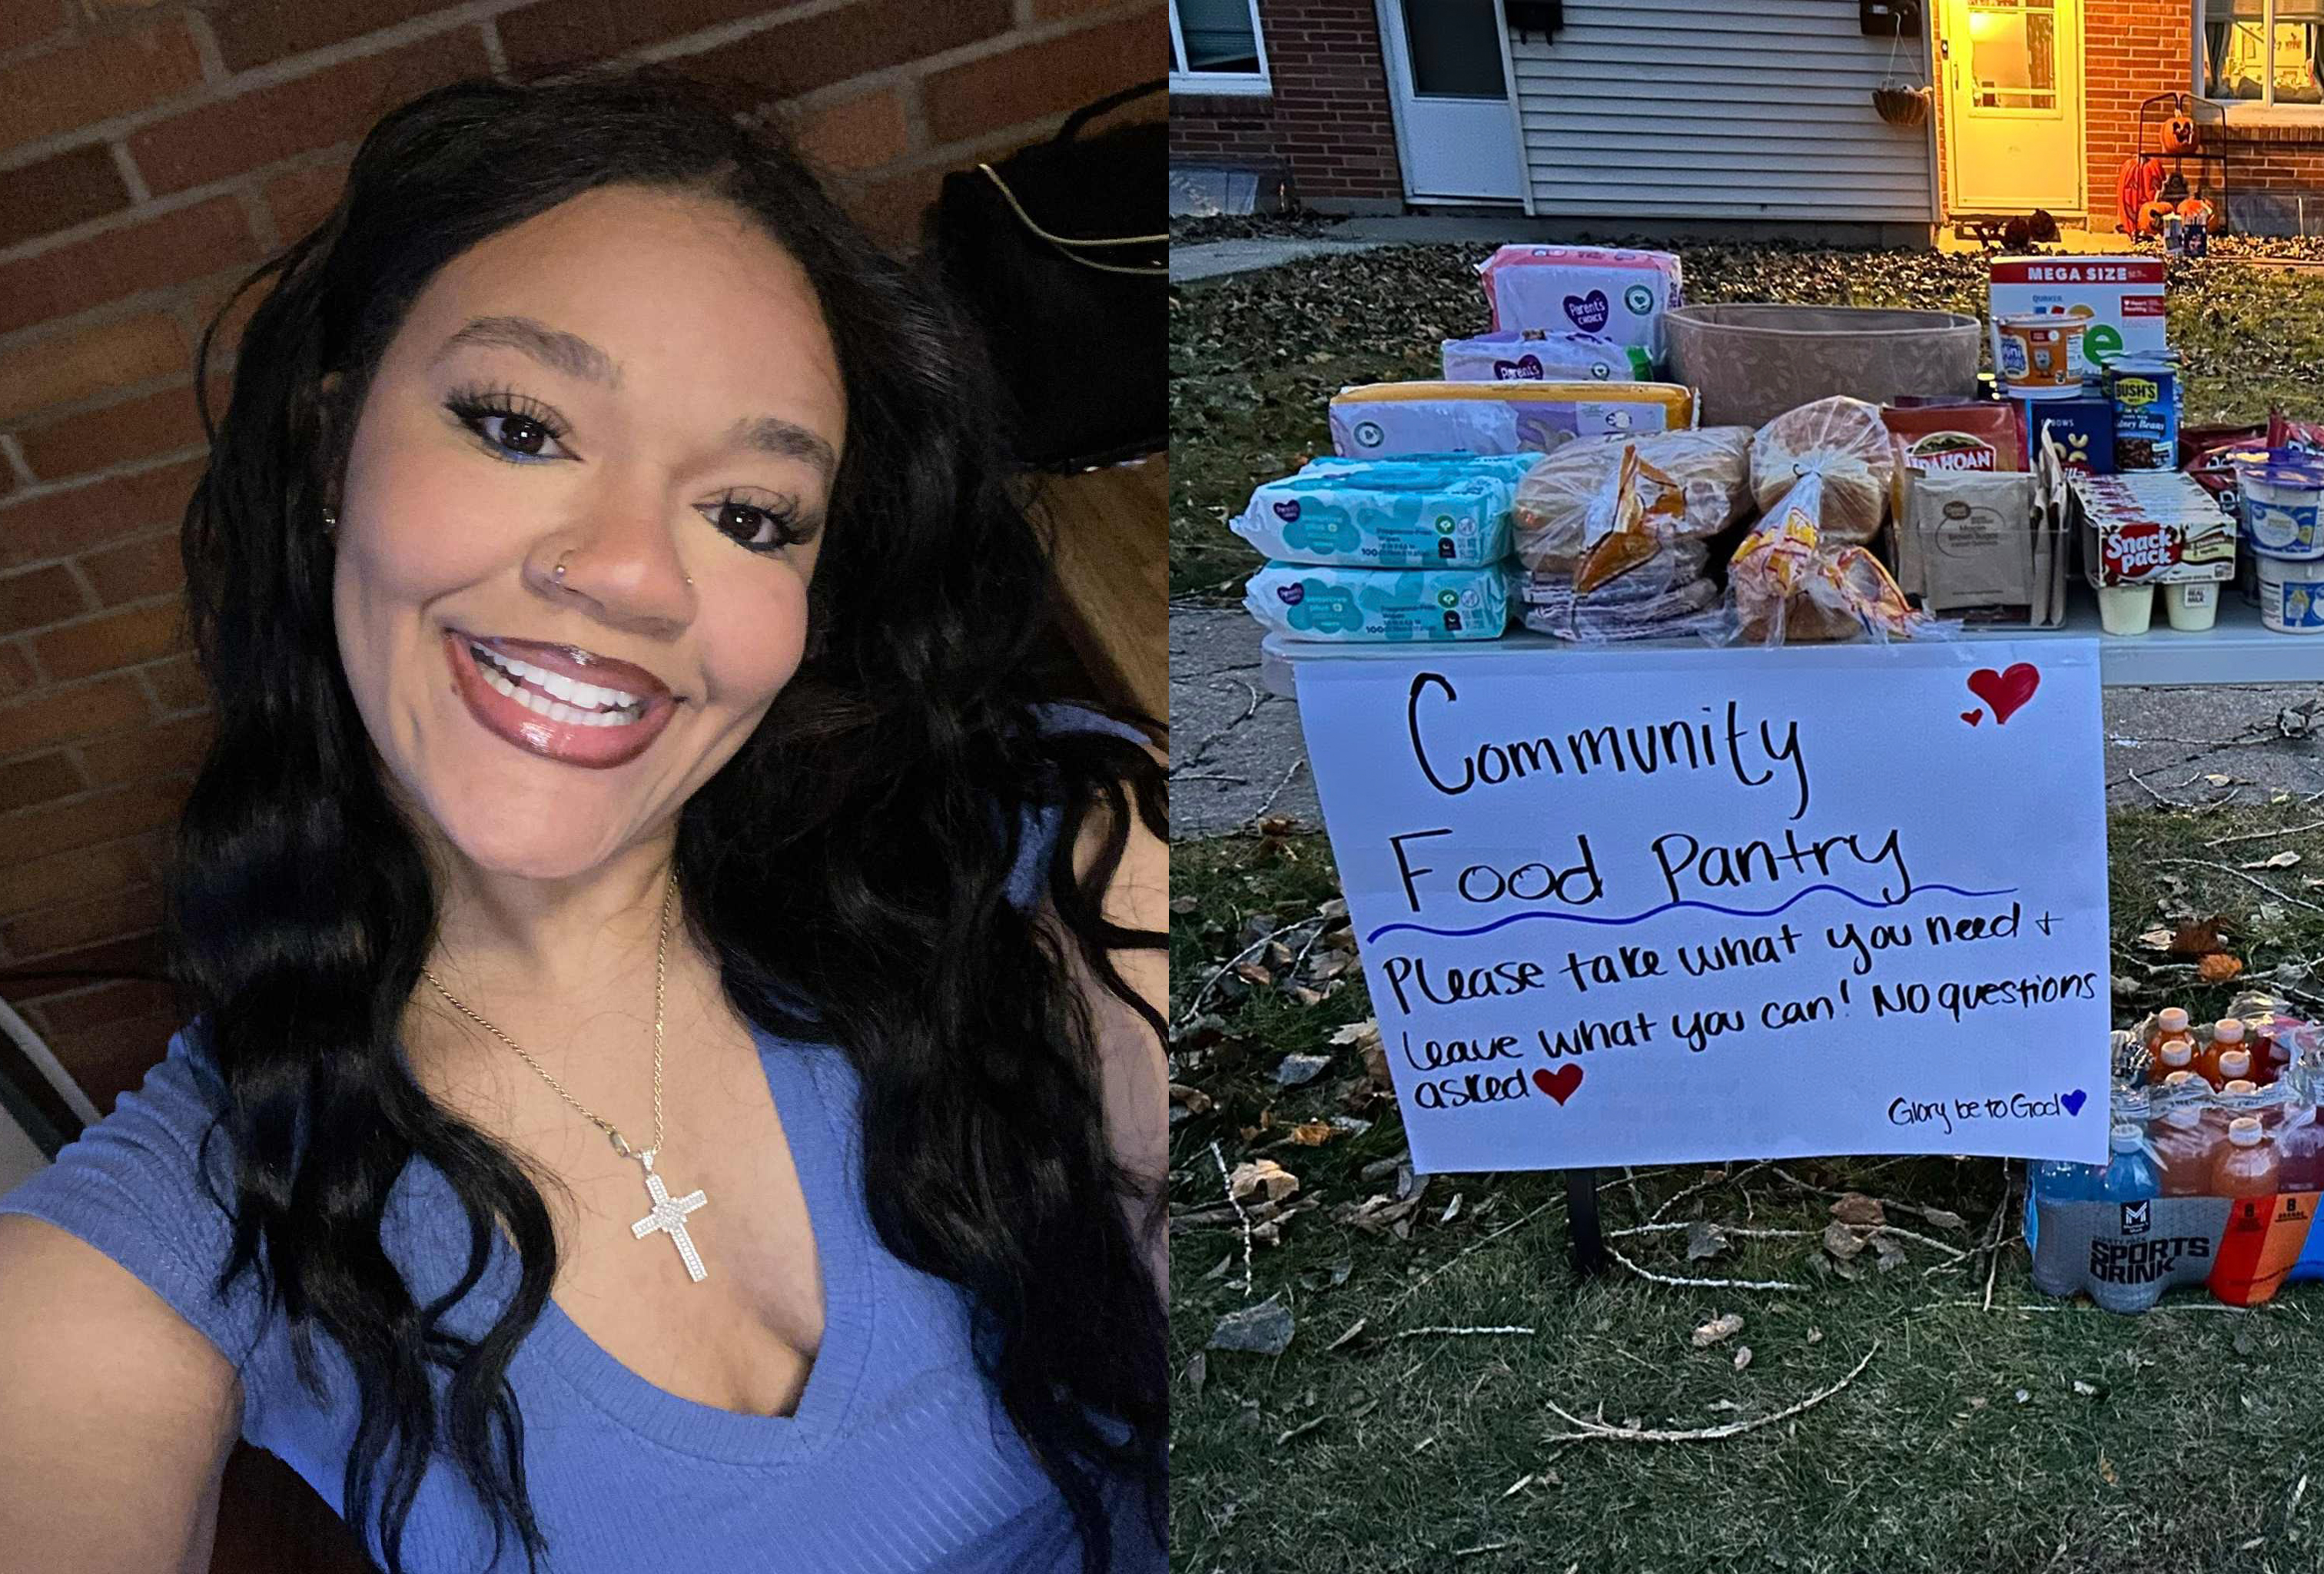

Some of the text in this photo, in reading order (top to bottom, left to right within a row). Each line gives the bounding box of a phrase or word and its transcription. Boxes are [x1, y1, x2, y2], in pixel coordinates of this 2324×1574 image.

[2027, 267, 2081, 281] MEGA
[2086, 267, 2127, 281] SIZE
[1569, 298, 1605, 317] Parent's
[1577, 312, 1604, 325] CHOICE
[1500, 362, 1540, 380] Parent's
[2116, 384, 2156, 400] BUSH'S
[2040, 419, 2074, 427] BOWS
[1908, 450, 1991, 471] IDAHOAN
[1361, 547, 1378, 557] 100
[2107, 529, 2173, 559] Snack
[1366, 625, 1385, 634] 100
[1408, 672, 1809, 820] Community
[1389, 828, 1911, 912] Food Pantry
[1383, 955, 1545, 1015] Please
[1559, 945, 1668, 993] take
[1678, 924, 1803, 977] what
[1826, 923, 1912, 975] you
[1926, 902, 2021, 945] need
[1538, 1012, 1658, 1059] what
[1672, 1010, 1745, 1053] you
[1761, 978, 1851, 1029] can!
[1937, 972, 2097, 1023] questions
[1414, 1068, 1530, 1109] asked
[1887, 1093, 2060, 1135] Glory be to God
[2090, 1236, 2210, 1265] SPORTS
[2090, 1256, 2176, 1285] DRINK
